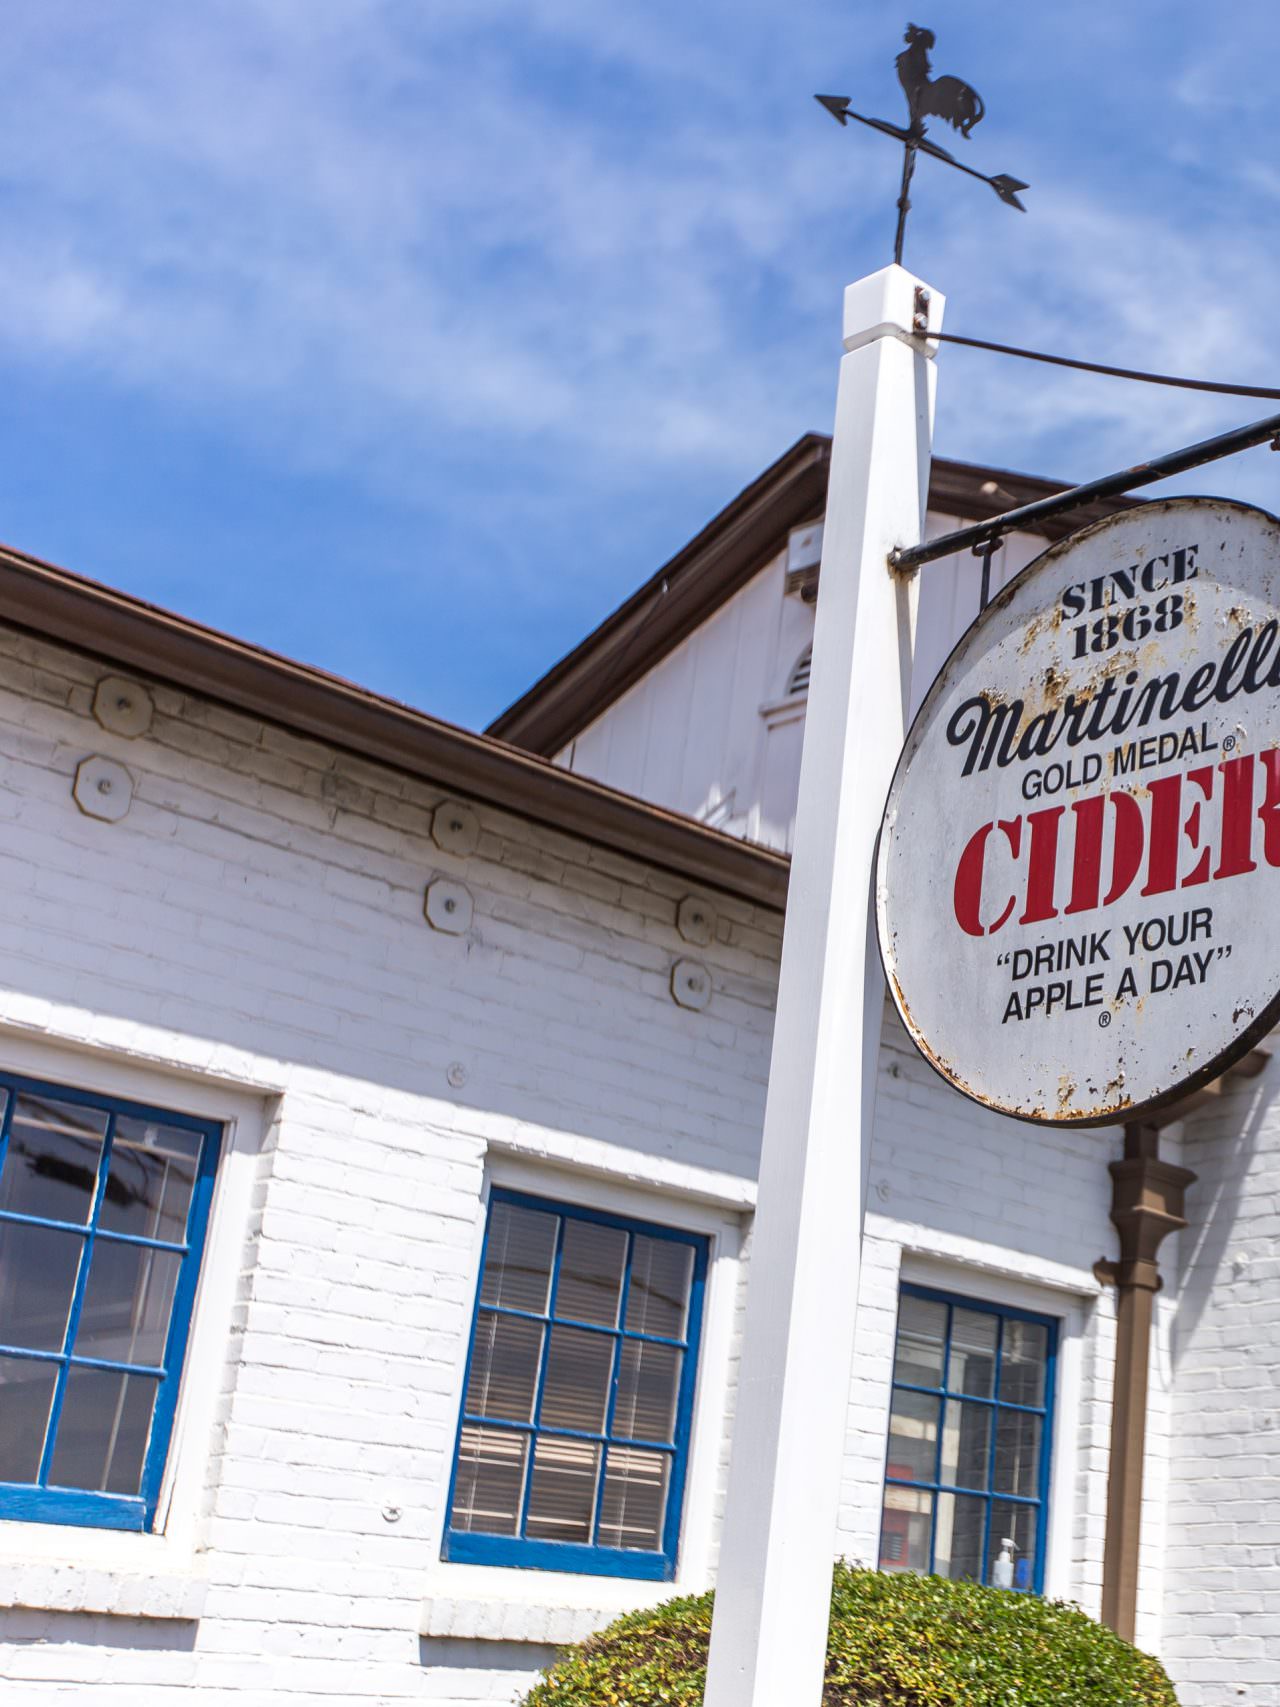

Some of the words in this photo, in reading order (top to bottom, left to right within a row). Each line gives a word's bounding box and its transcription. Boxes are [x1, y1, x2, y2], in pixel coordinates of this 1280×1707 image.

[1062, 544, 1199, 621] SINCE
[1072, 594, 1183, 660] 1868
[1022, 752, 1102, 799] GOLD
[1123, 907, 1213, 955] YOUR
[1001, 973, 1105, 1024] APPLE
[1115, 967, 1138, 1000] A
